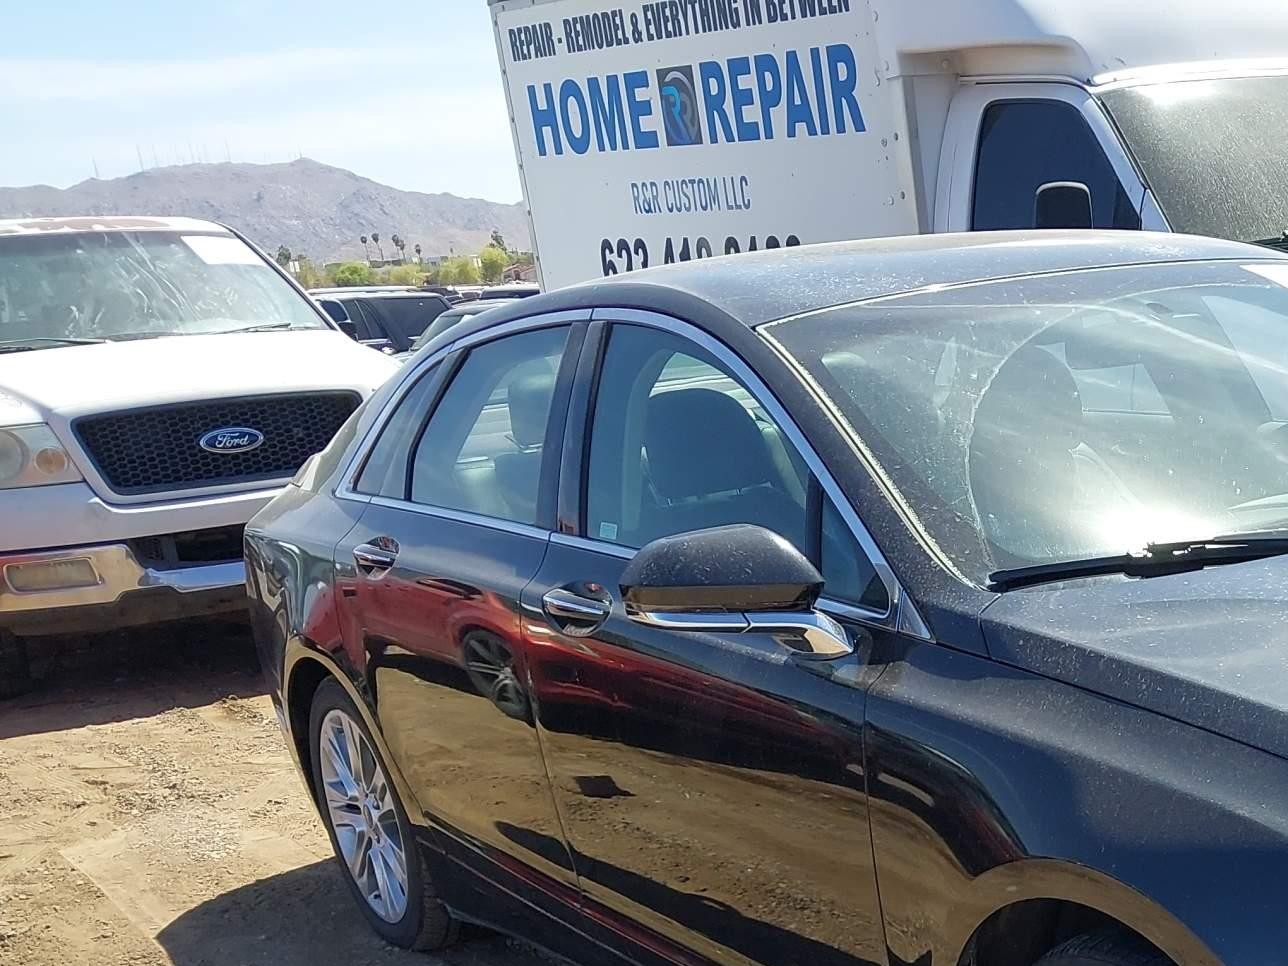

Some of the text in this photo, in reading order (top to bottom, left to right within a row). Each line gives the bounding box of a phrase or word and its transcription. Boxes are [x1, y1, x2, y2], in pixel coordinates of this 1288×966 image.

[508, 22, 557, 62] REPAIR
[562, 9, 630, 54] REMODEL
[630, 12, 643, 44] &
[642, 0, 741, 42] EVERYTHING
[743, 0, 763, 27] IN
[526, 43, 867, 157] HOME REPAIR
[631, 175, 751, 214] R&R CUSTOM LLC
[215, 432, 250, 448] Ford
